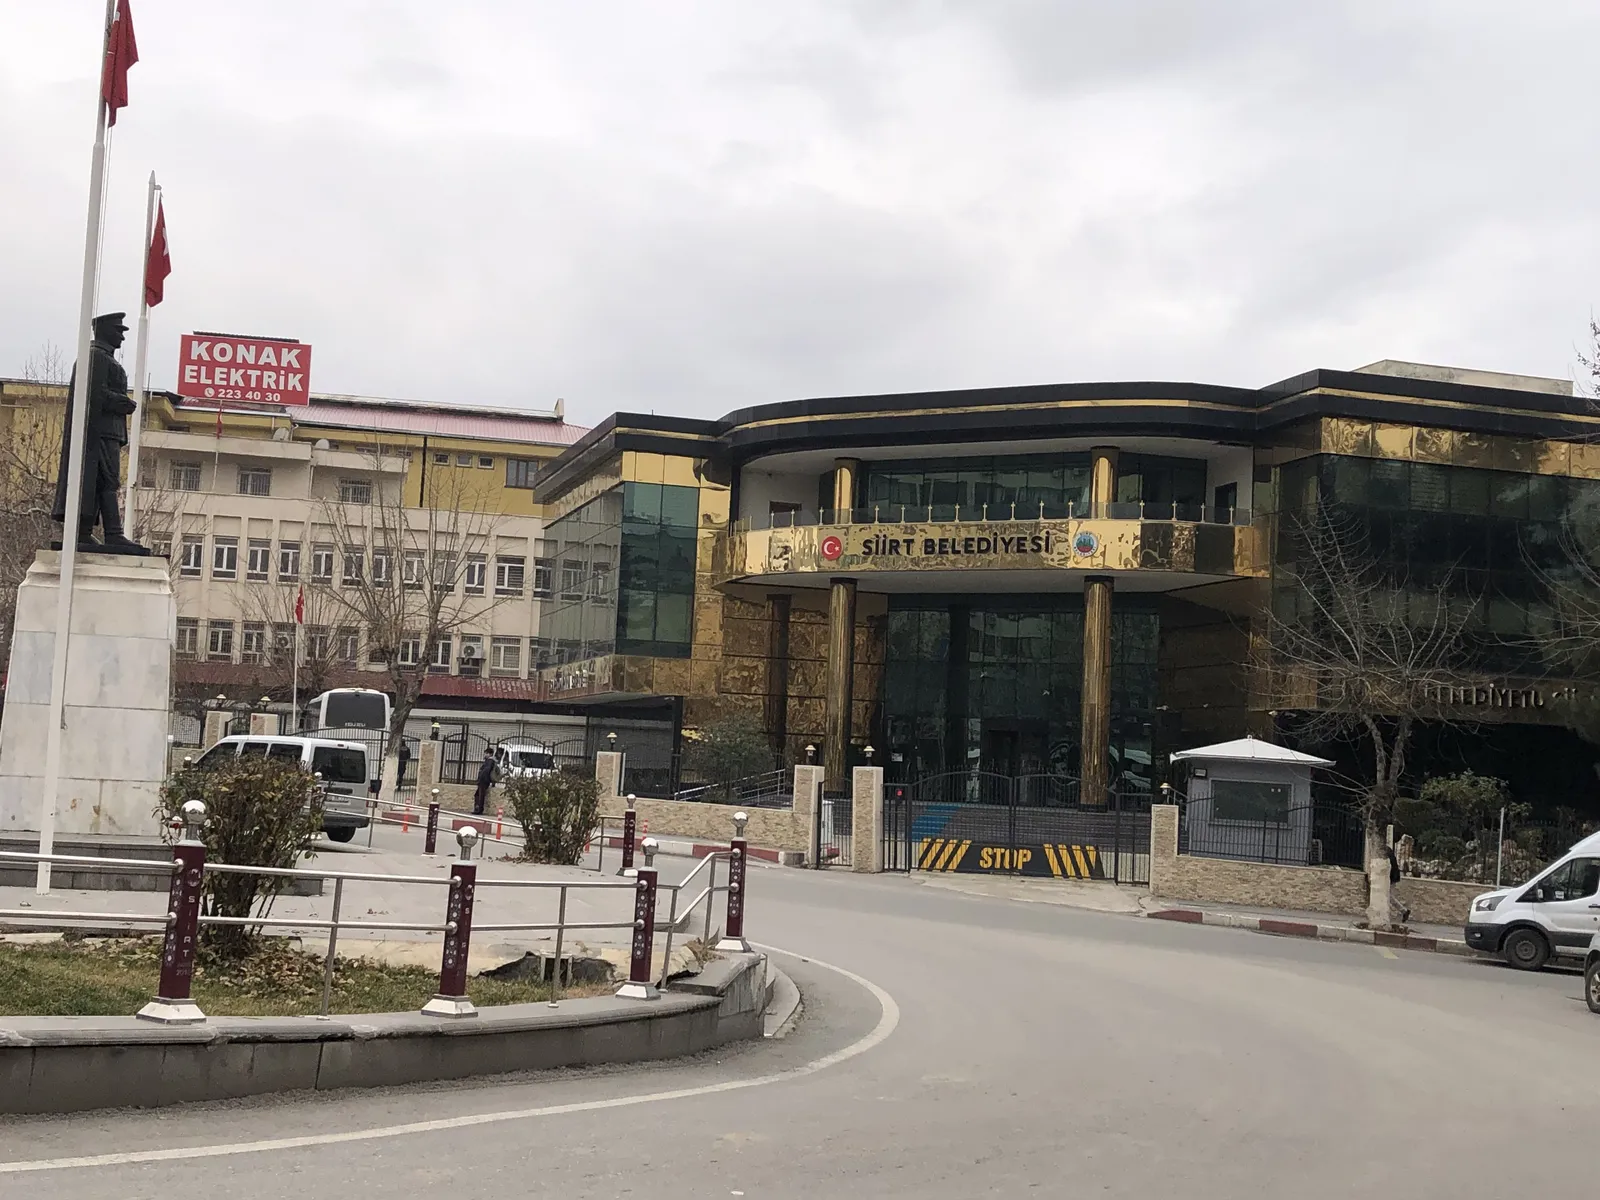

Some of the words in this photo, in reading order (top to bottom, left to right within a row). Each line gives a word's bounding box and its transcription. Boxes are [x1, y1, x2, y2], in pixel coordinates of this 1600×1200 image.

[190, 340, 302, 368] KONAK
[218, 388, 241, 398] 223
[245, 390, 261, 401] 40
[265, 392, 281, 402] 30
[862, 534, 915, 555] SİİRT
[923, 530, 1051, 555] BELEDİYESİ
[979, 847, 1032, 870] STOP
